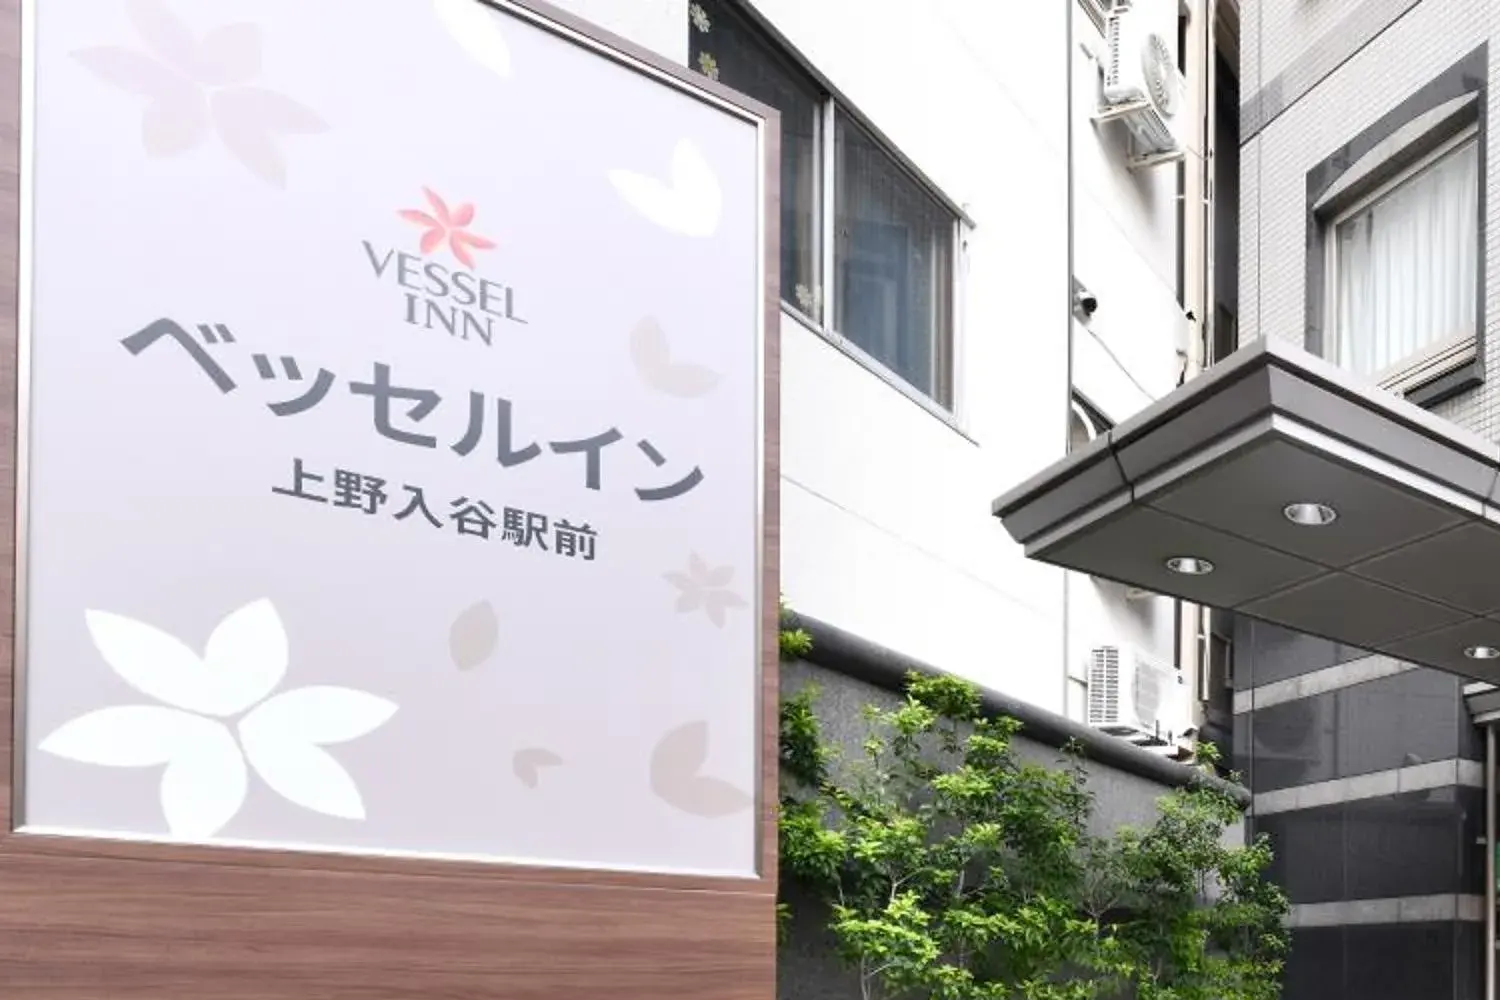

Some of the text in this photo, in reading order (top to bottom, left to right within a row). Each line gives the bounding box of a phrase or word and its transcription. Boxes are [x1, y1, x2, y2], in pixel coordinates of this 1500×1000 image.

[361, 239, 529, 325] VESSEL
[403, 292, 496, 347] INN
[119, 317, 704, 501] ベッセルイン
[271, 457, 598, 562] 上野入谷駅前
